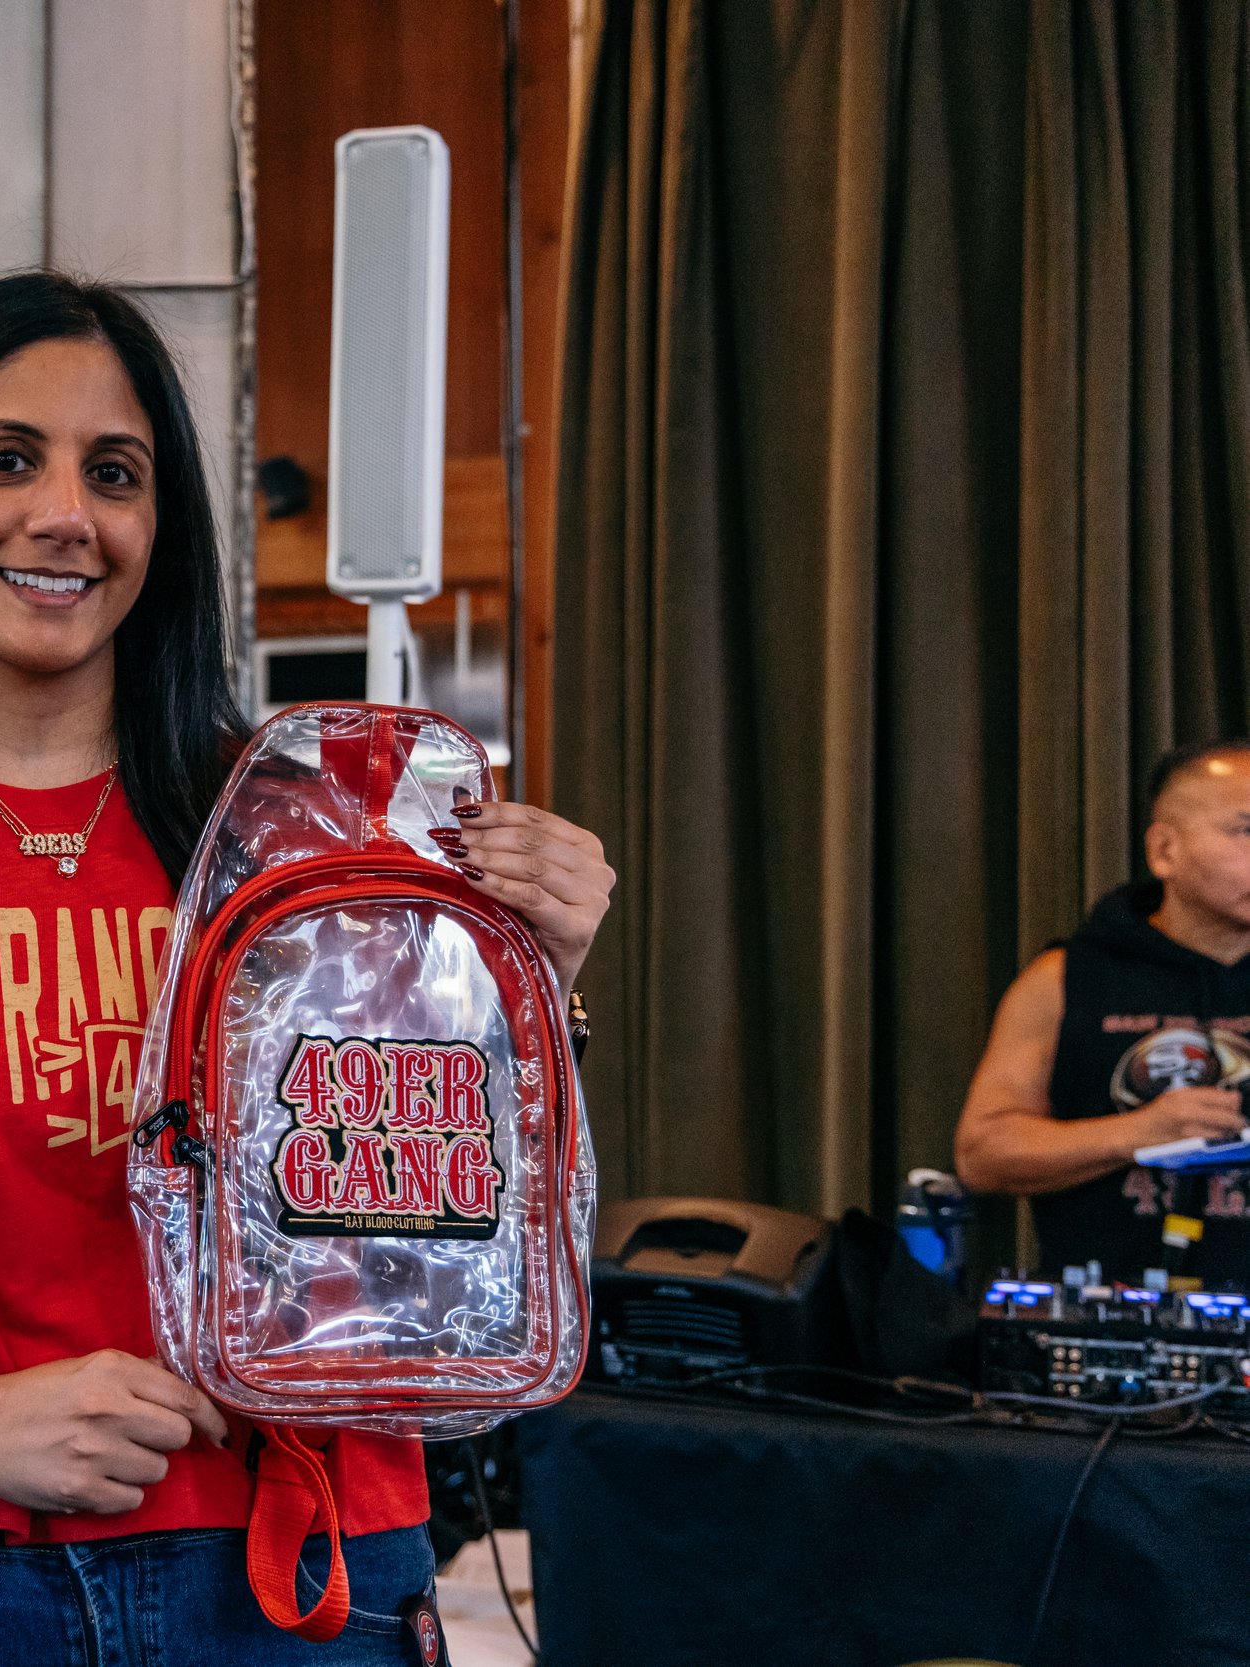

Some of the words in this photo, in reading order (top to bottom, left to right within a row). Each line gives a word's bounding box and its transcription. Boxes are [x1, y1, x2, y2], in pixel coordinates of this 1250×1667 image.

[19, 832, 87, 855] 49ERS
[282, 1038, 492, 1133] 49ER
[274, 1128, 501, 1219] GANG
